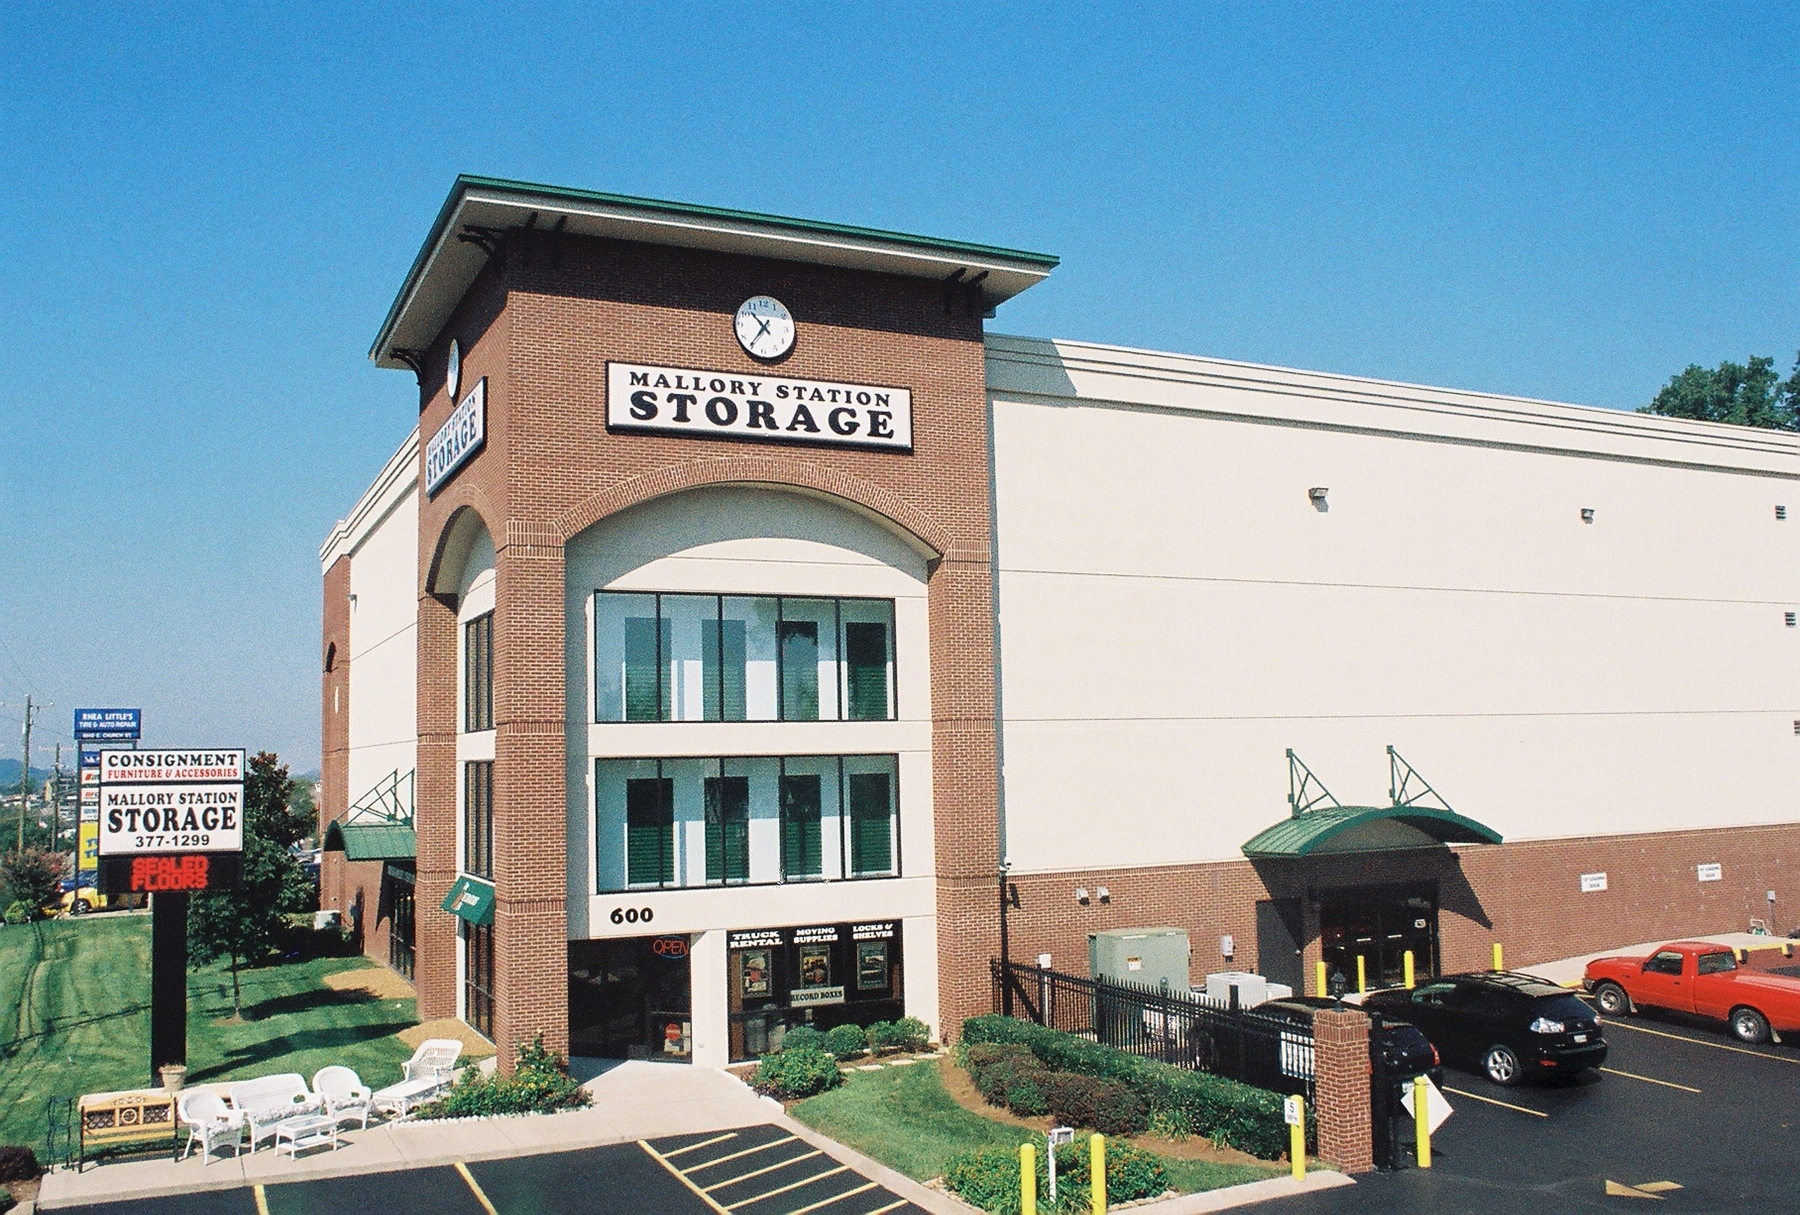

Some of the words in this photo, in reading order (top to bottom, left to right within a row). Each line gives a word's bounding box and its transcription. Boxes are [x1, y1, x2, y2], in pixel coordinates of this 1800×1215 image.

[629, 371, 762, 396] MALLORY
[776, 385, 890, 407] STATION
[629, 390, 894, 439] STORAGE
[427, 410, 477, 485] STORAGE
[108, 754, 237, 767] CONSIGNMENT
[108, 769, 162, 779] FURNITURE
[165, 769, 172, 778] &
[175, 768, 238, 778] ACCESSORIES
[108, 793, 174, 806] MALLORY
[179, 792, 237, 805] STATION
[108, 807, 236, 833] STORAGE
[135, 834, 210, 848] 377-1299
[132, 855, 209, 873] SEALED
[131, 872, 208, 891] FLOORS
[610, 907, 654, 925] 600
[796, 927, 835, 936] MOVING
[853, 924, 883, 932] LOCKS
[732, 931, 780, 941] TRUCK
[794, 935, 838, 944] SUPPLIES
[853, 931, 894, 940] SHELVES
[652, 939, 689, 955] OPEN
[730, 938, 783, 948] RENTAL
[820, 990, 843, 999] BOXES
[1290, 1102, 1295, 1113] 5
